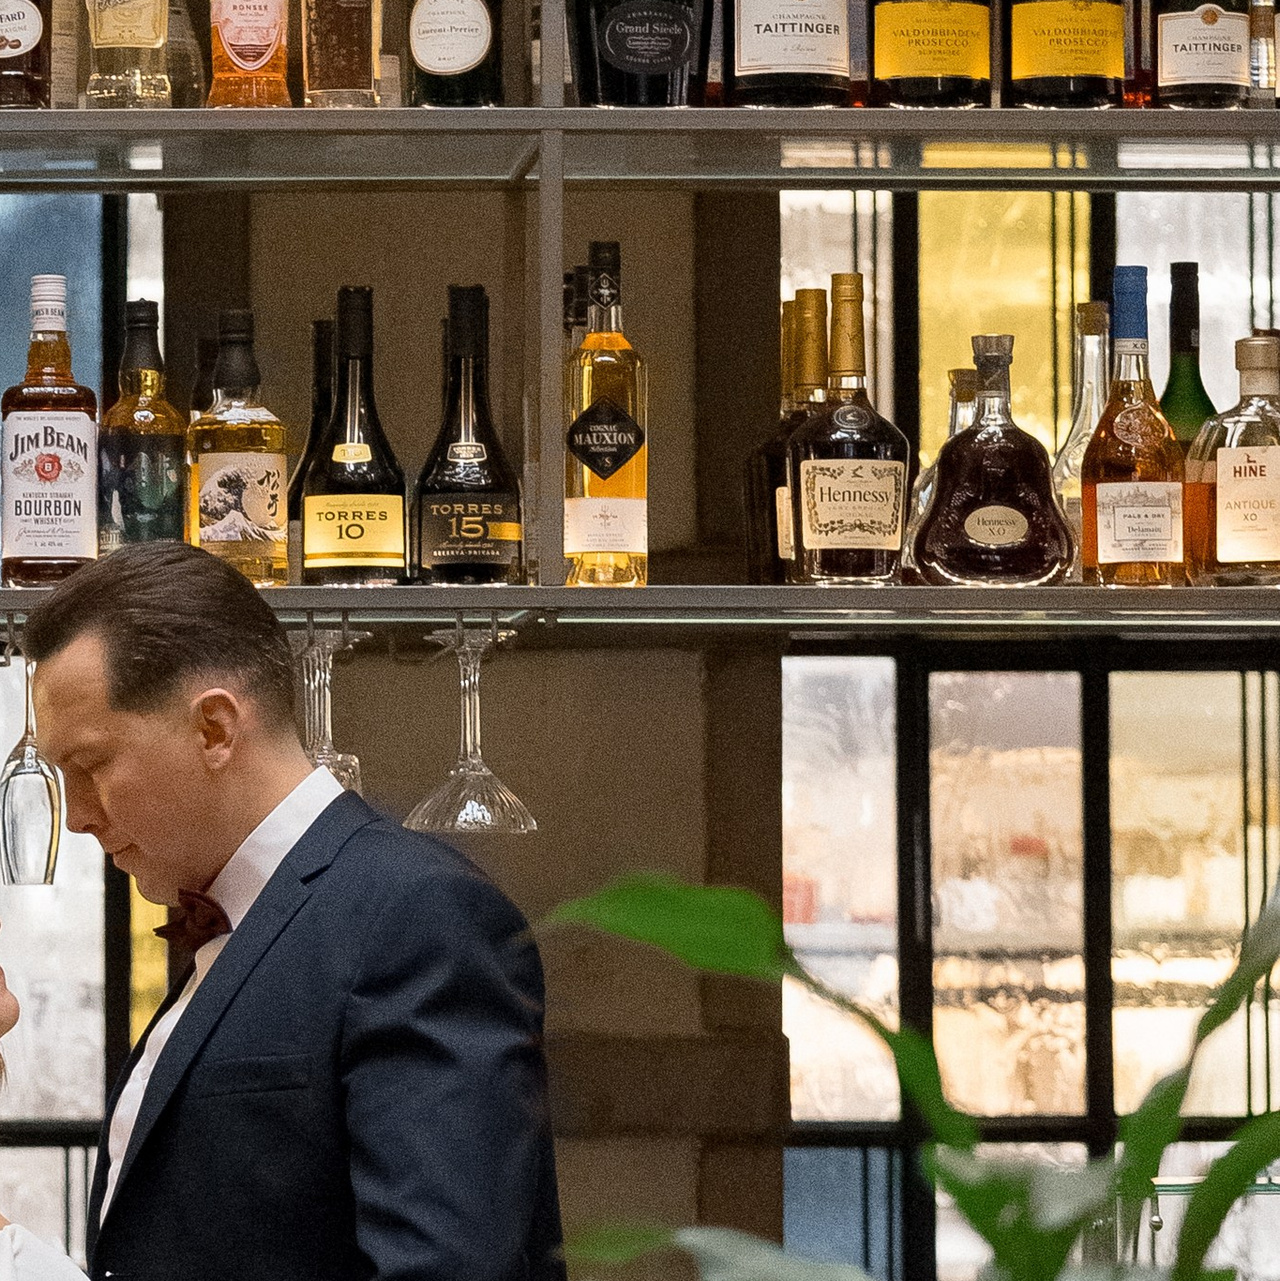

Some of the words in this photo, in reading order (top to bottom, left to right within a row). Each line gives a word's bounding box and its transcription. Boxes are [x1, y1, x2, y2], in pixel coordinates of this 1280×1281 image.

[772, 12, 827, 20] CHAMPAGNE
[417, 25, 479, 36] Laurent-Perrier
[616, 21, 649, 34] Grand
[754, 22, 841, 35] TAITTINGER
[907, 37, 969, 48] PROSECCO
[1049, 37, 1109, 47] PROSECCO
[1172, 43, 1243, 53] TAITTINGER
[589, 424, 618, 432] COGNAC
[9, 432, 40, 461] JIM
[43, 426, 89, 463] BEAM
[573, 432, 636, 446] MAUXION
[1233, 465, 1267, 478] HINE
[819, 486, 889, 507] Hennessy
[14, 500, 82, 516] BOURBON
[430, 503, 503, 516] TORRES
[1224, 500, 1277, 510] ANTIQUE
[33, 517, 62, 525] WHISKEY
[316, 510, 388, 521] TORRES
[1243, 513, 1258, 522] XO
[976, 517, 1016, 526] Hennessy
[336, 523, 365, 540] 10
[448, 516, 485, 539] 15
